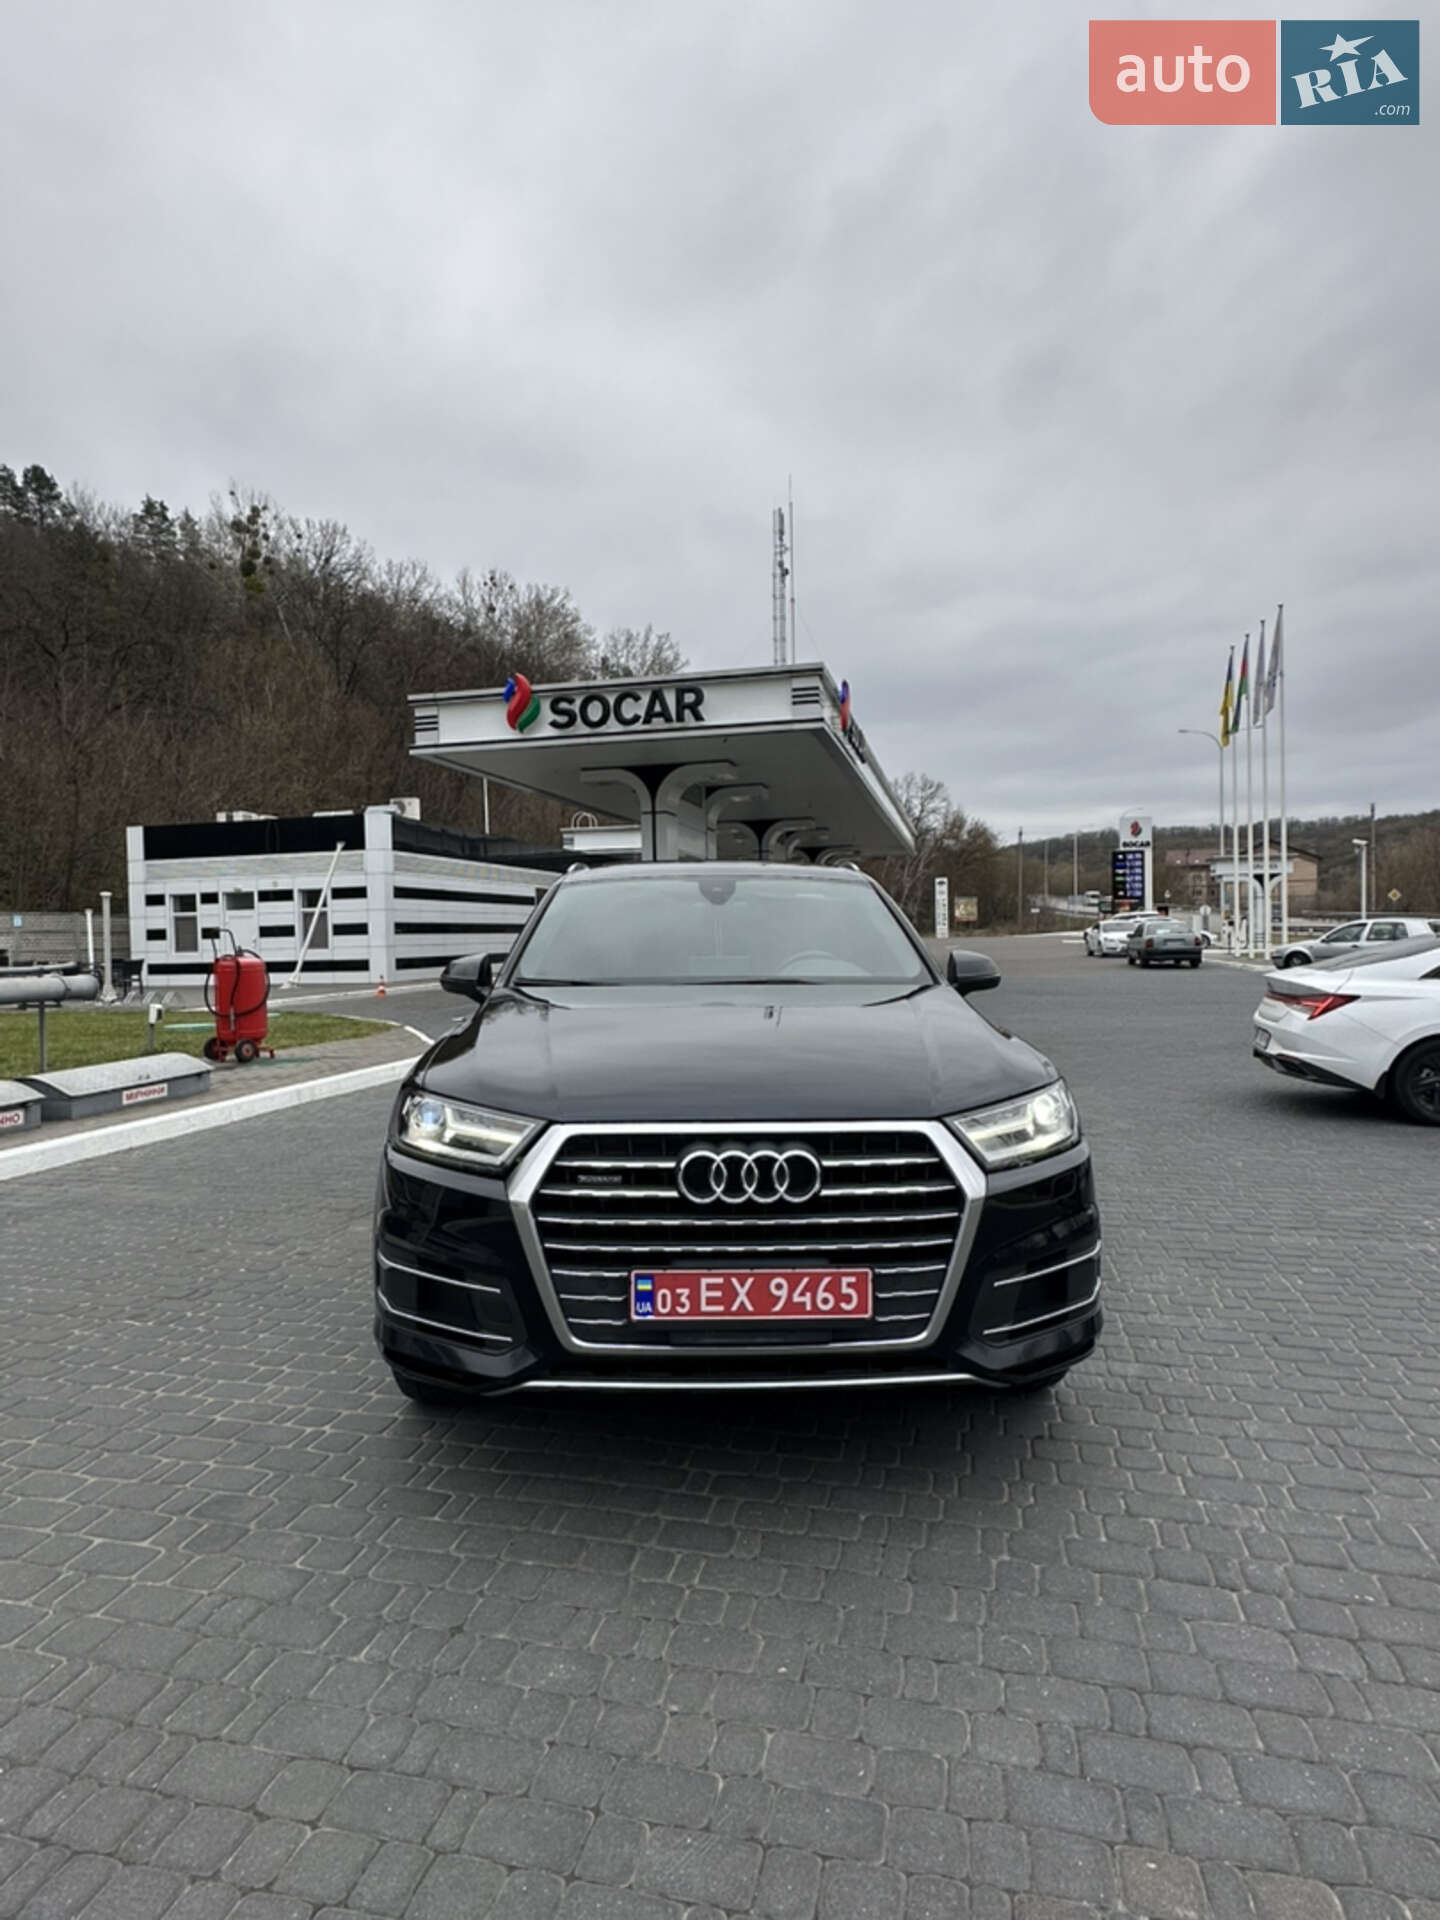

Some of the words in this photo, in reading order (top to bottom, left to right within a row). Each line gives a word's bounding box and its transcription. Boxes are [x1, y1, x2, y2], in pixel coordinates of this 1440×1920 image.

[548, 683, 706, 730] SOCAR
[636, 1301, 653, 1313] UA
[768, 1276, 859, 1312] 9465
